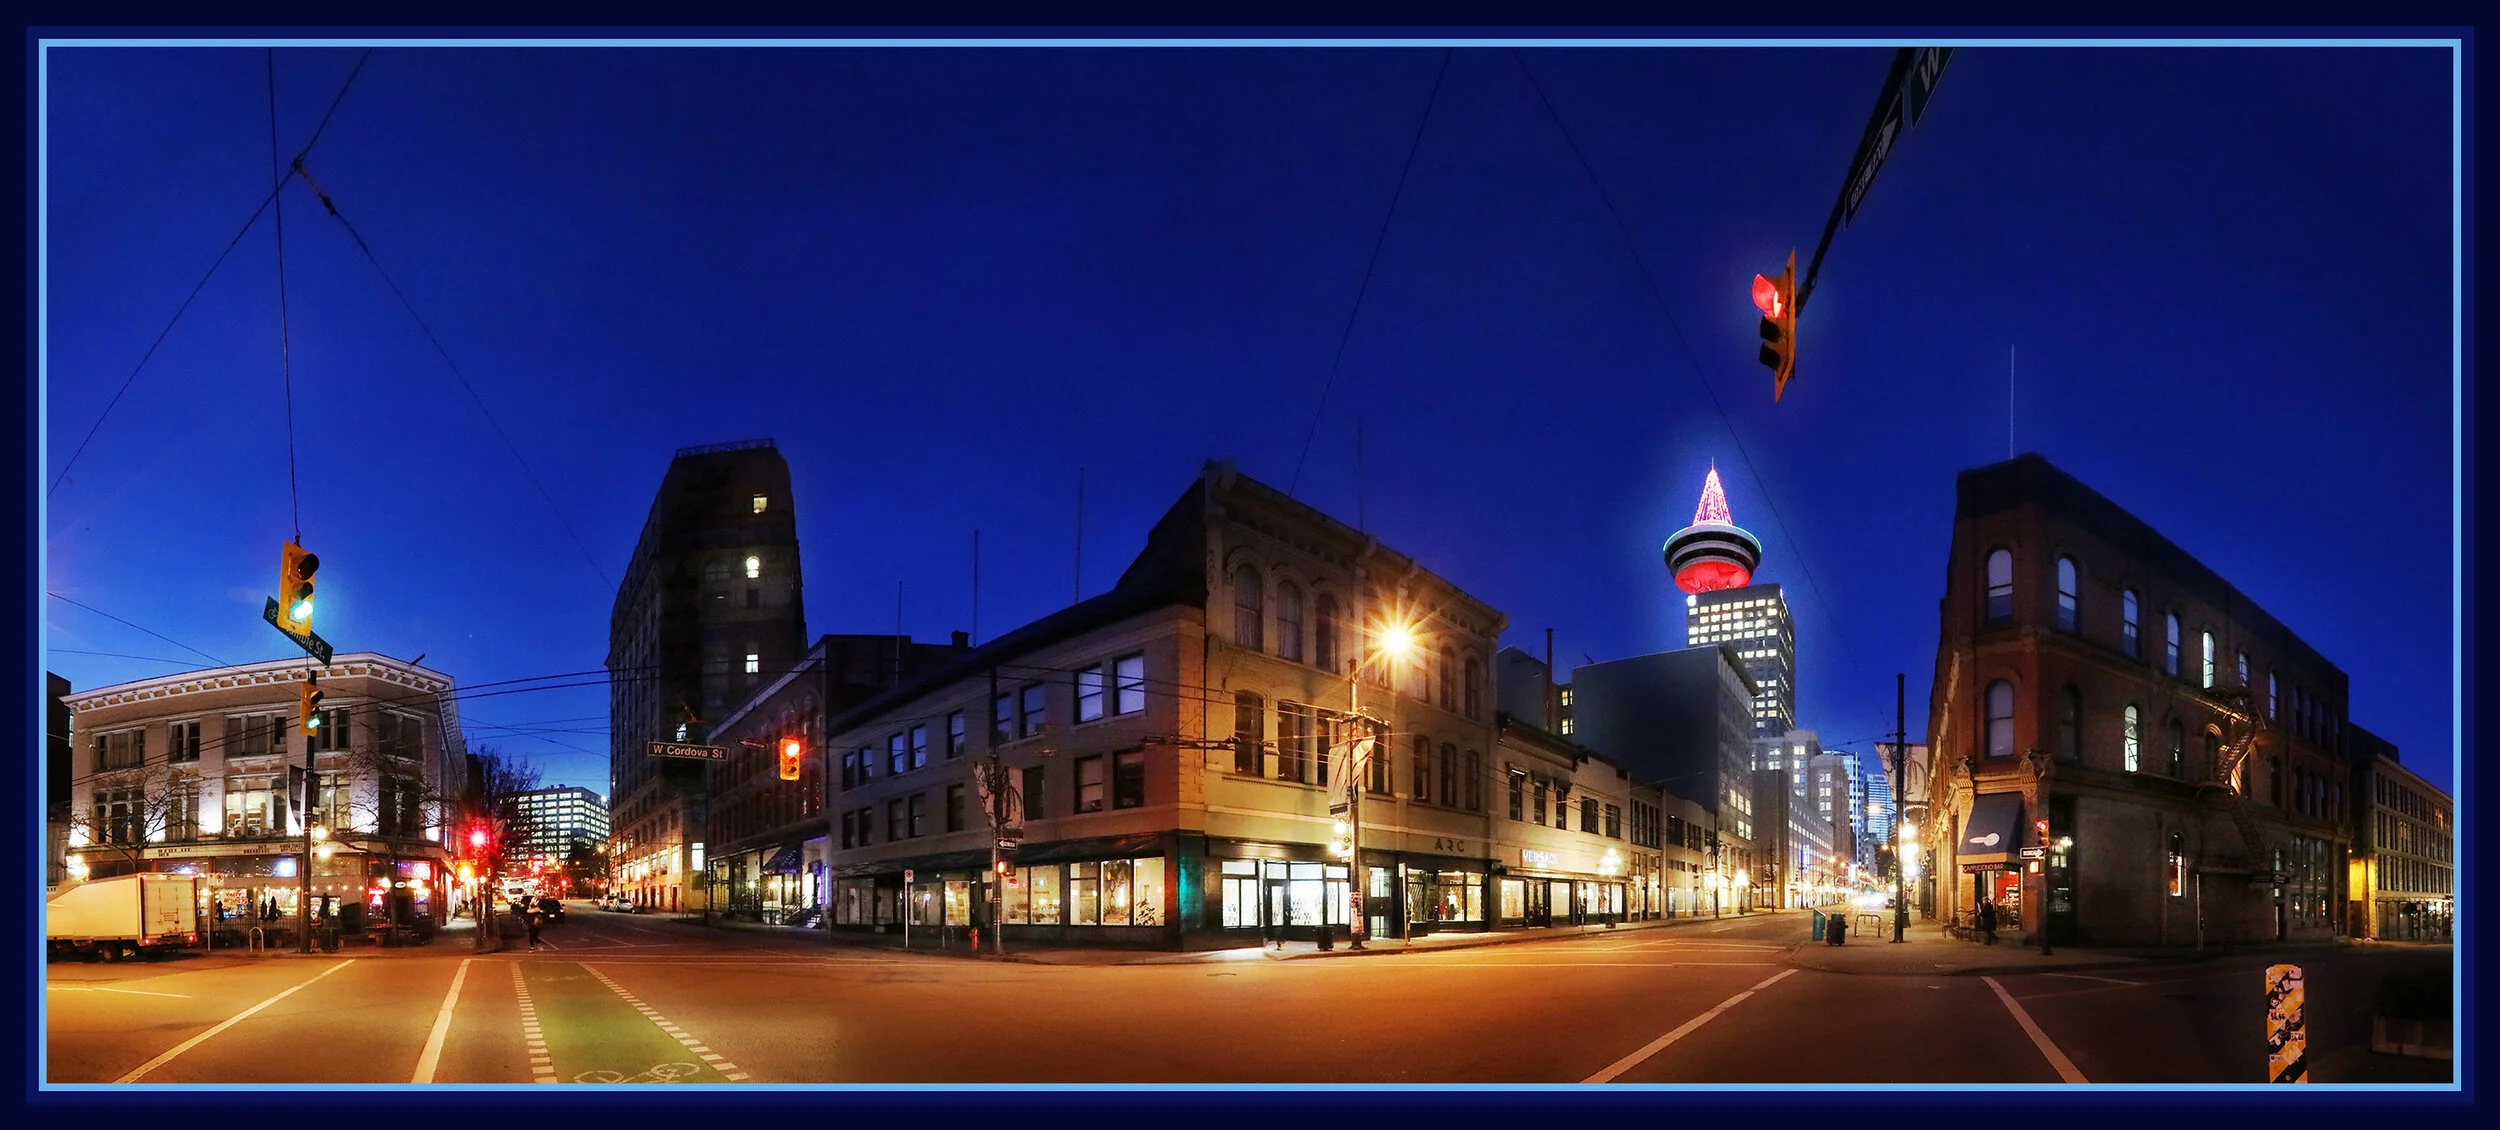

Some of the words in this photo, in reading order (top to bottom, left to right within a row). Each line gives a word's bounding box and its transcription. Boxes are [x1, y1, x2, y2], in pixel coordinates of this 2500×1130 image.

[314, 641, 325, 659] St.
[653, 745, 663, 754] W
[667, 745, 708, 757] Cordova
[712, 749, 723, 758] St
[1523, 849, 1559, 865] VERSACE
[1963, 863, 1994, 873] CAPPUCCINO
[1994, 862, 2004, 871] BAR
